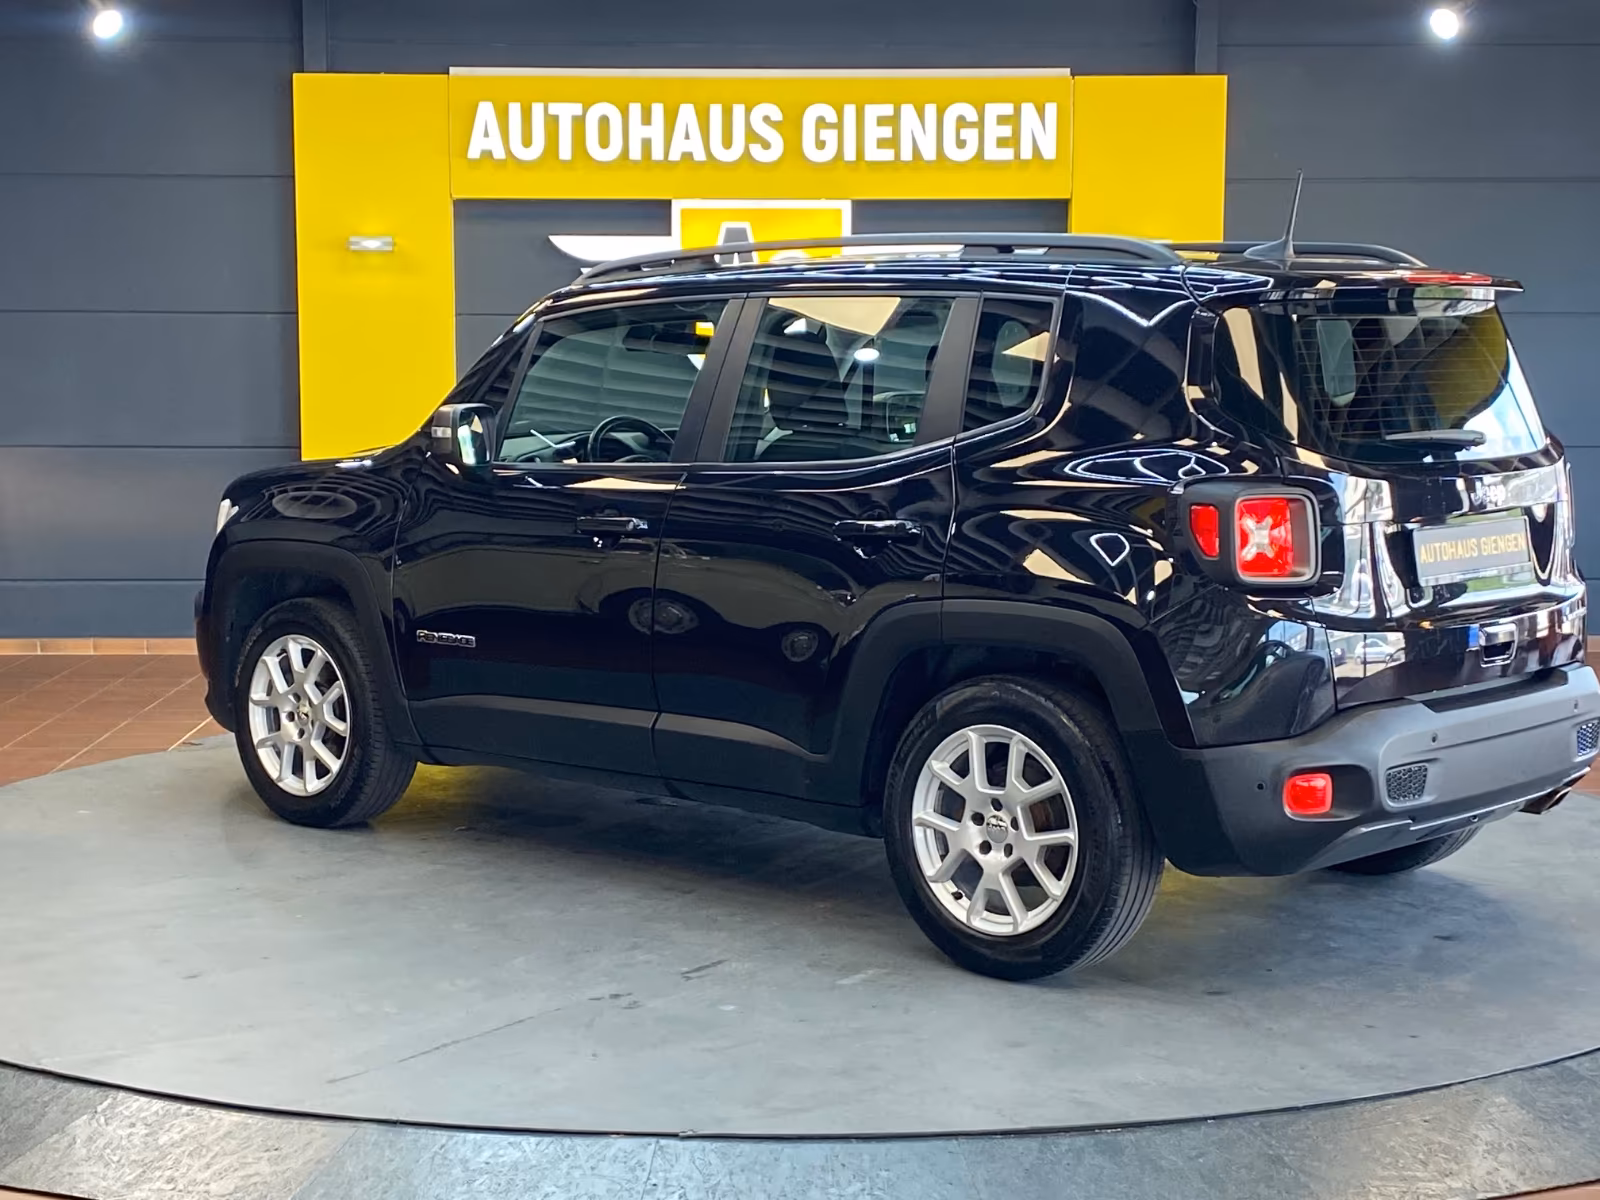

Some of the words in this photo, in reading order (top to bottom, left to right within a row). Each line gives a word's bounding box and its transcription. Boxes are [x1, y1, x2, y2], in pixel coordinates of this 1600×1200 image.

[466, 100, 784, 162] AUTOHAUS
[801, 101, 1058, 162] GIENGEN
[1420, 538, 1478, 564] AUTOHAUS
[1480, 532, 1526, 556] GIENGEN
